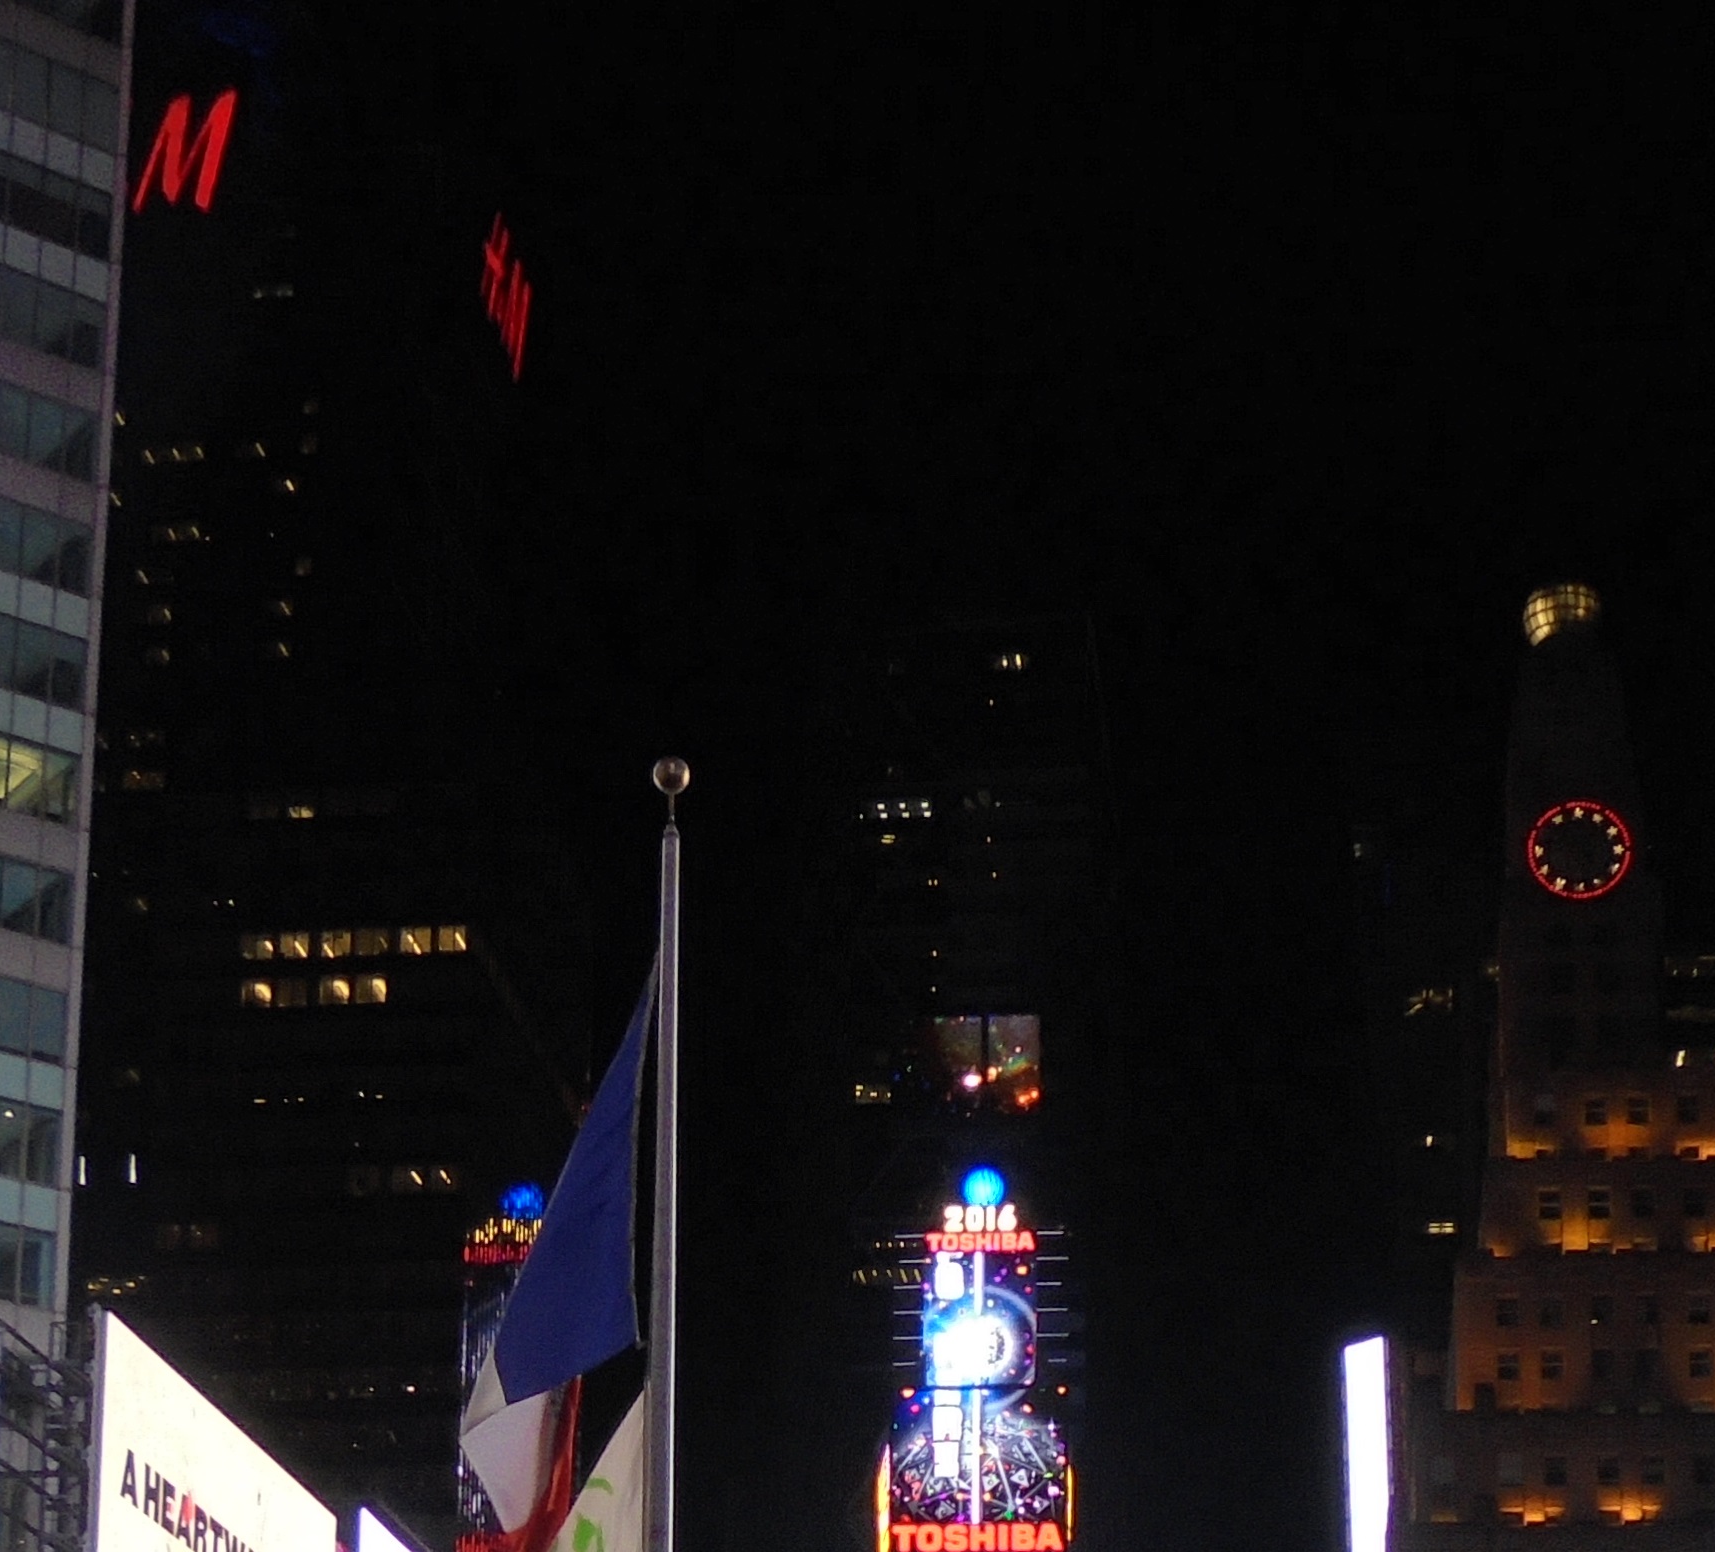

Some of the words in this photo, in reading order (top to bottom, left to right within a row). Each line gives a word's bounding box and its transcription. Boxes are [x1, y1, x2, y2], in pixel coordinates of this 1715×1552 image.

[944, 1204, 1017, 1231] 2016
[926, 1231, 1036, 1252] TOSHIBA
[120, 1449, 139, 1504] A
